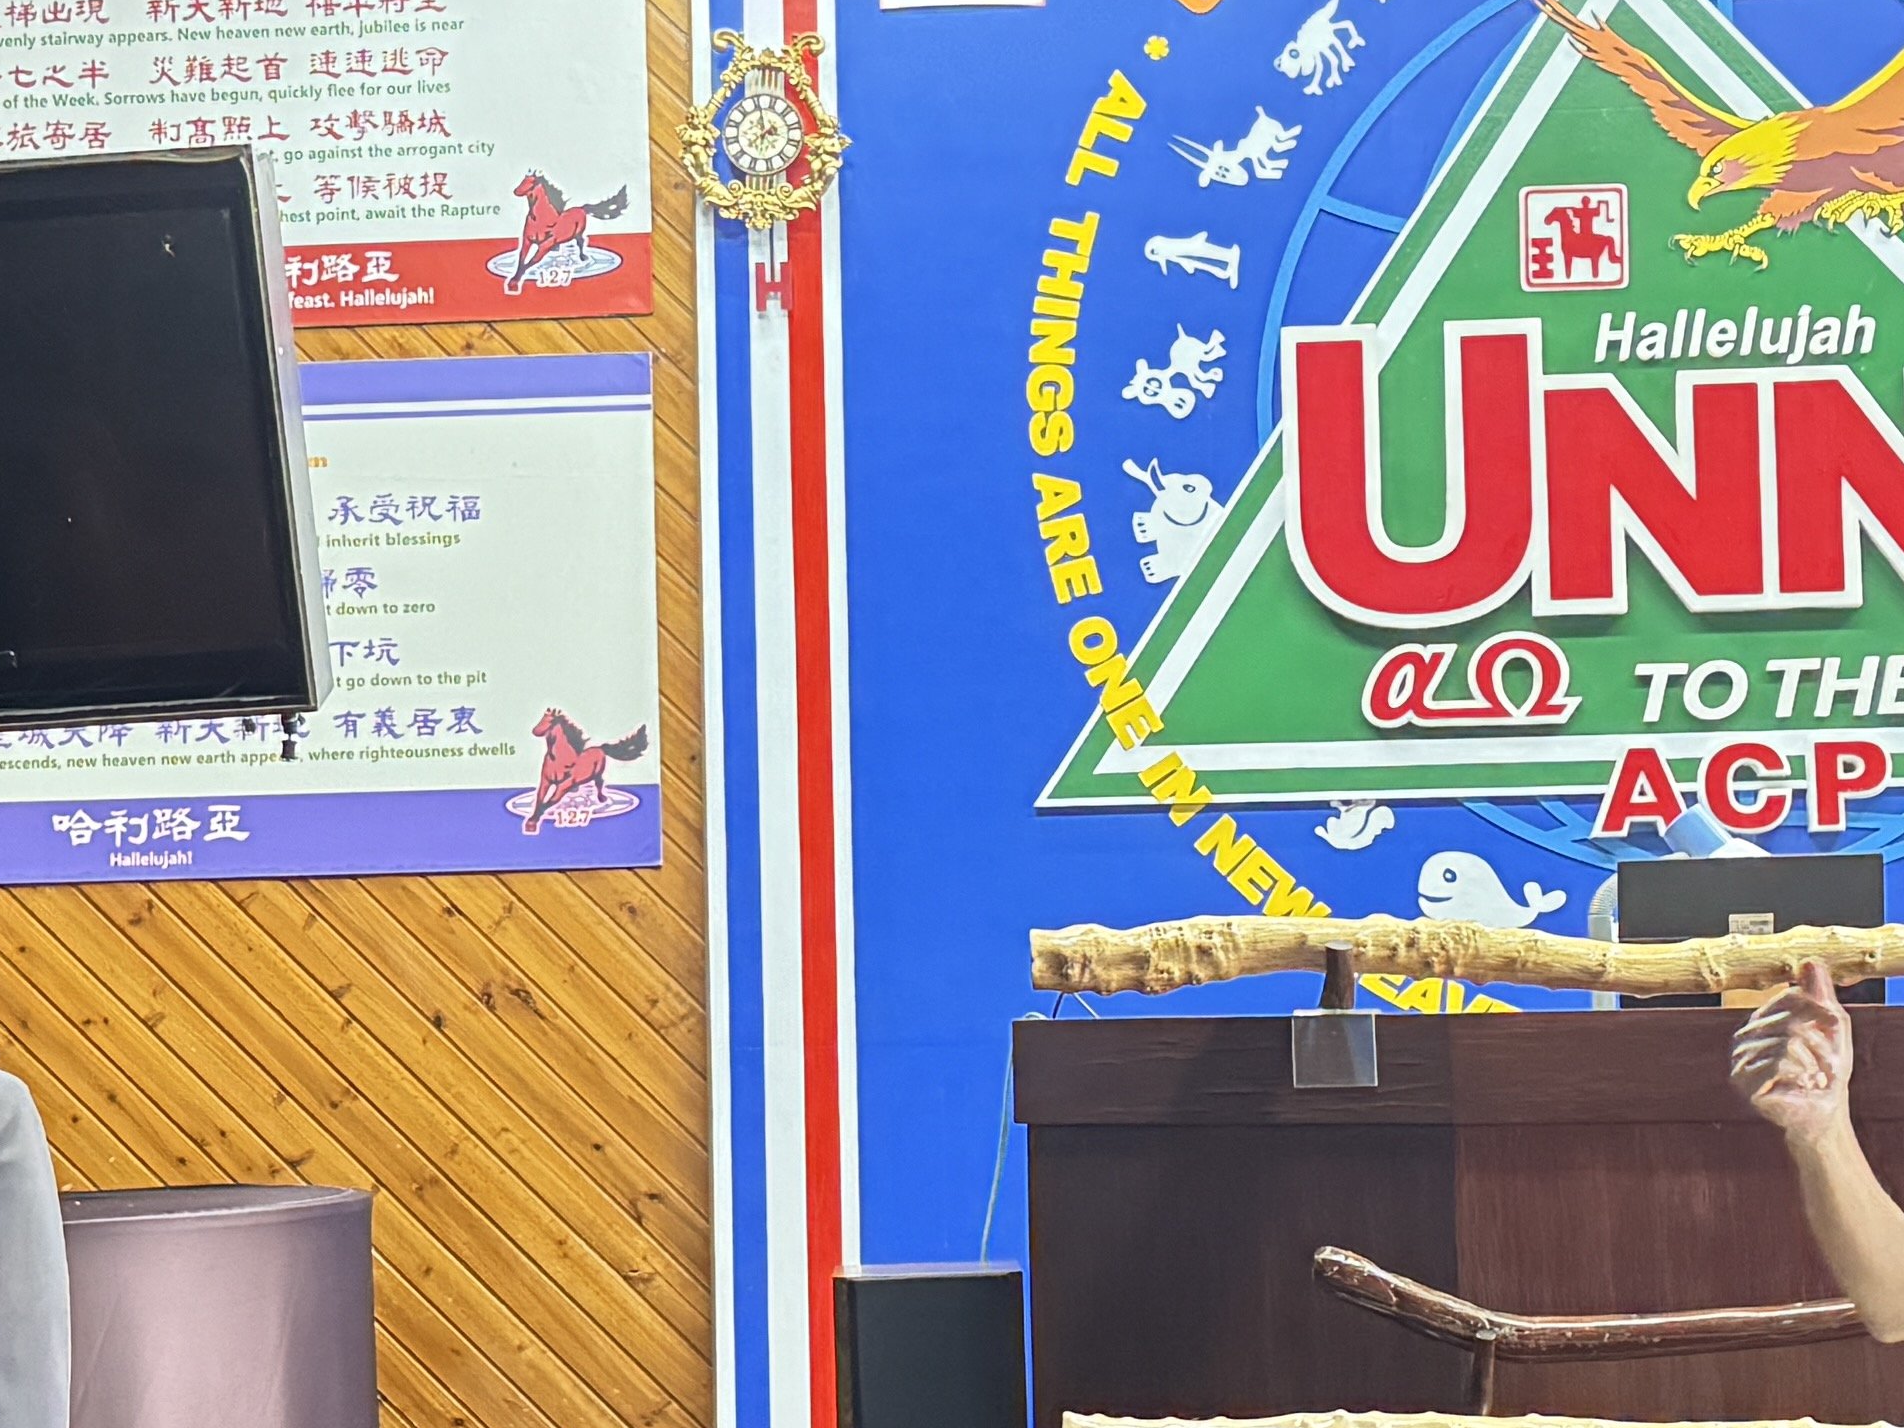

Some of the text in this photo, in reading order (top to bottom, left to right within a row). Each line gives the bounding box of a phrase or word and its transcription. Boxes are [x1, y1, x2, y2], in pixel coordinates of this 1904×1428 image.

[41, 30, 103, 50] stairway
[216, 24, 269, 41] heaven
[431, 18, 465, 32] near
[2, 95, 21, 109] of
[24, 93, 47, 108] the
[104, 89, 166, 106] Sorrows
[170, 87, 206, 103] have
[268, 83, 322, 103] quickly
[327, 83, 355, 98] flee
[417, 80, 451, 95] lives
[308, 140, 496, 162] against arrogant city
[313, 172, 454, 204] 等候被提
[365, 203, 502, 223] await Rapture
[339, 287, 435, 311] Hallelujah!
[1594, 303, 1878, 366] Hallelujah
[1024, 67, 1334, 919] ALL THINGS ARE ONE IN NEW
[327, 492, 481, 526] 承受祝福
[326, 531, 461, 549] inherit blessings
[336, 601, 436, 616] down zero
[370, 673, 412, 688] down
[1635, 658, 1749, 723] TO
[101, 751, 157, 768] heaven
[197, 749, 236, 765] earth
[308, 746, 355, 762] where
[359, 743, 464, 764] righteousness
[468, 742, 516, 758] dwells
[1592, 734, 1893, 839] ACP
[52, 804, 250, 849] 哈利路亞
